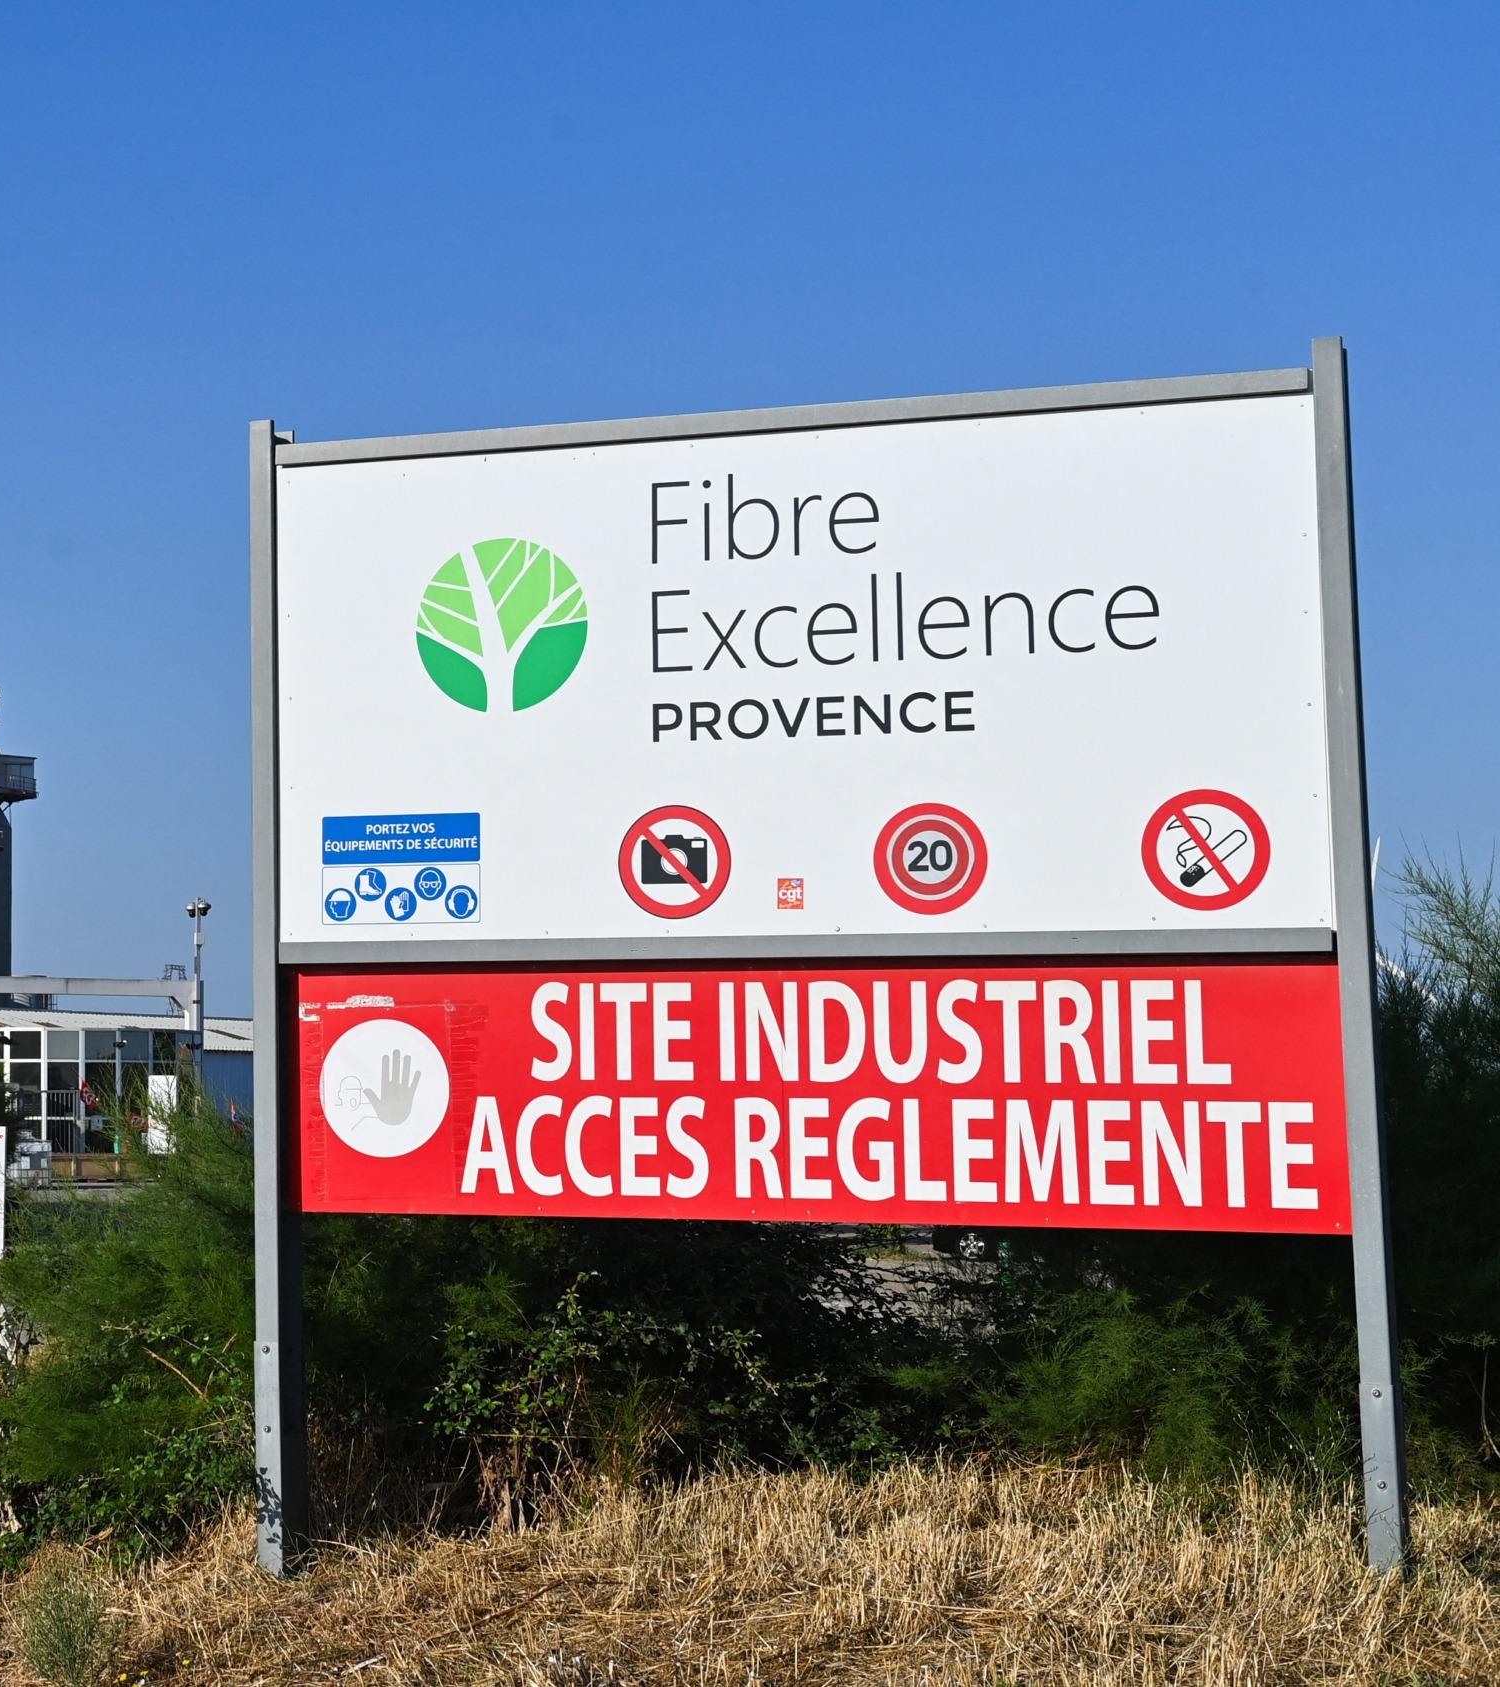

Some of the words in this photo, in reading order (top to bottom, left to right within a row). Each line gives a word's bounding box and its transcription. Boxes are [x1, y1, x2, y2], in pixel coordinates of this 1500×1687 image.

[652, 474, 880, 564] Fibre
[652, 572, 1160, 673] Excellence
[652, 690, 975, 742] PROVENCE
[324, 839, 404, 853] ÉQUIPEMENTS
[406, 839, 422, 850] DE
[425, 836, 478, 849] SÉCURITÉ
[365, 824, 409, 835] PORTEZ
[412, 823, 435, 834] VOS
[907, 840, 953, 872] 20
[779, 887, 803, 902] cgt
[532, 981, 694, 1082] SITE
[718, 979, 1232, 1085] INDUSTRIEL
[461, 1095, 709, 1199] ACCES
[734, 1096, 1319, 1210] REGLEMENTE
